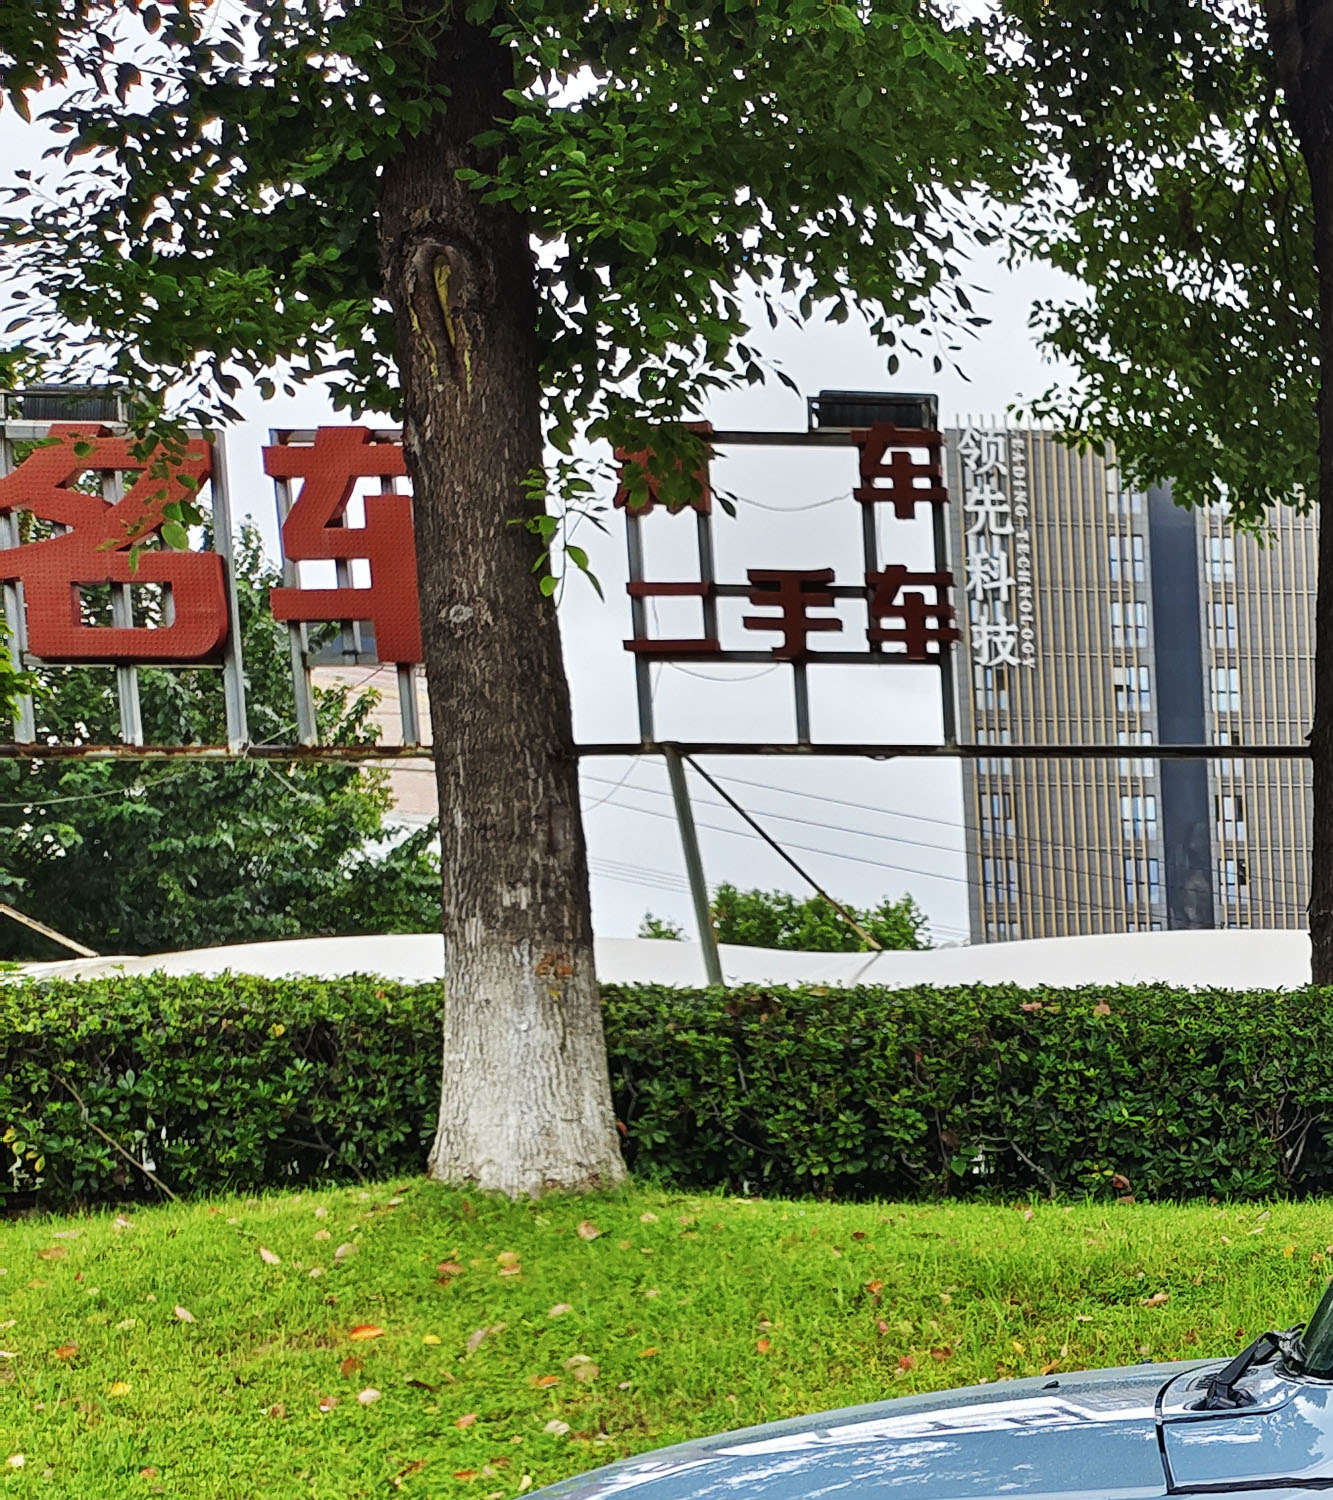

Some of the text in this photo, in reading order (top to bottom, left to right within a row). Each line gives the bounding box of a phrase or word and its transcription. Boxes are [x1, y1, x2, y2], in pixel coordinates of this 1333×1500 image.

[623, 565, 961, 661] 二手车
[957, 428, 1020, 668] 领先科技
[1014, 527, 1036, 669] TECHNOLOGY
